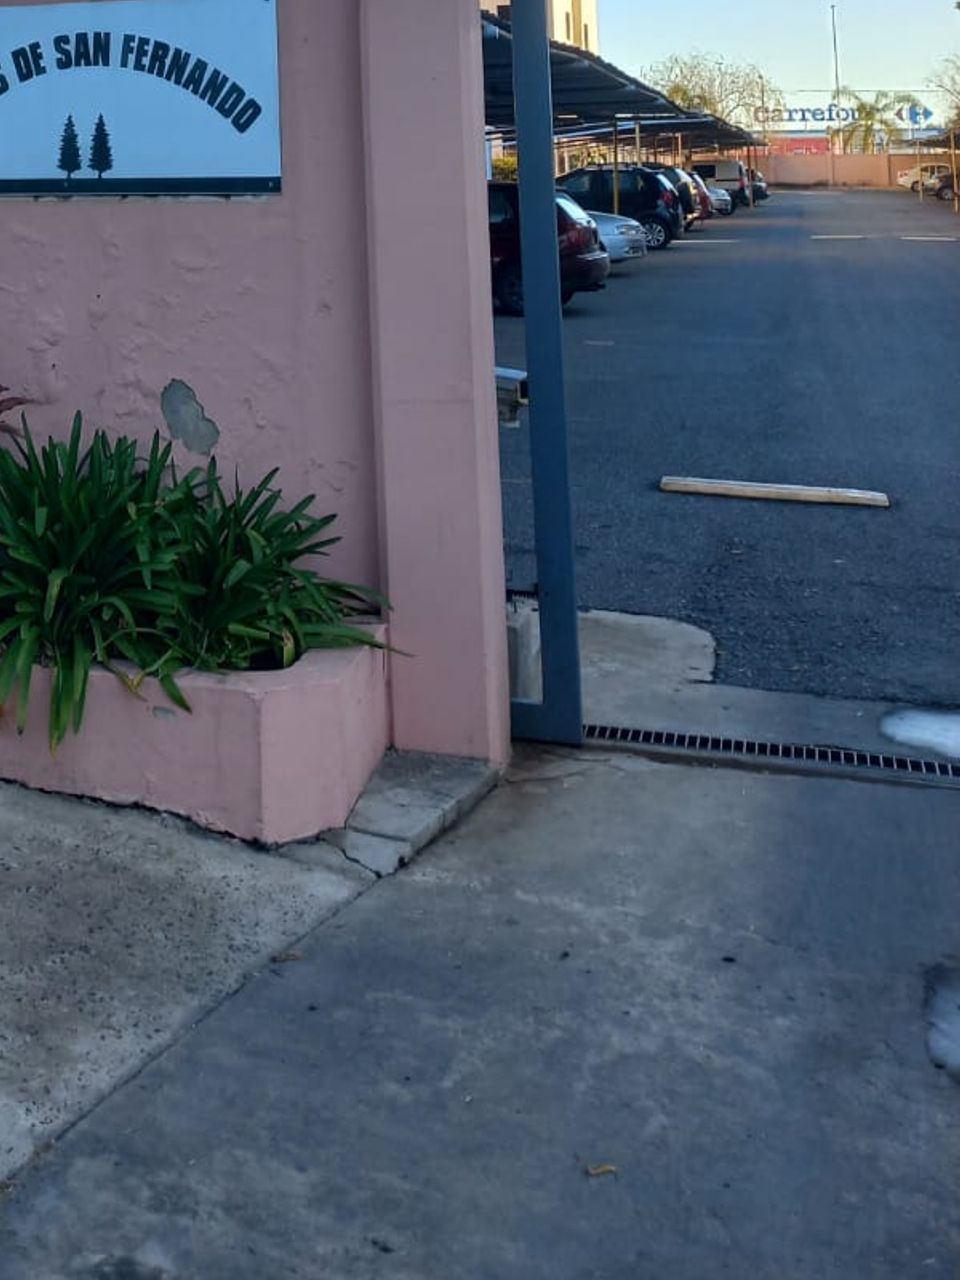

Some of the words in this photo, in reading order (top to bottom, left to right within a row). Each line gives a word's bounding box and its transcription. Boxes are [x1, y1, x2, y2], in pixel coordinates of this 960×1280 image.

[11, 41, 47, 83] DE
[52, 31, 112, 71] SAN
[119, 33, 263, 135] FERNANDO
[753, 103, 865, 123] Carrefo
